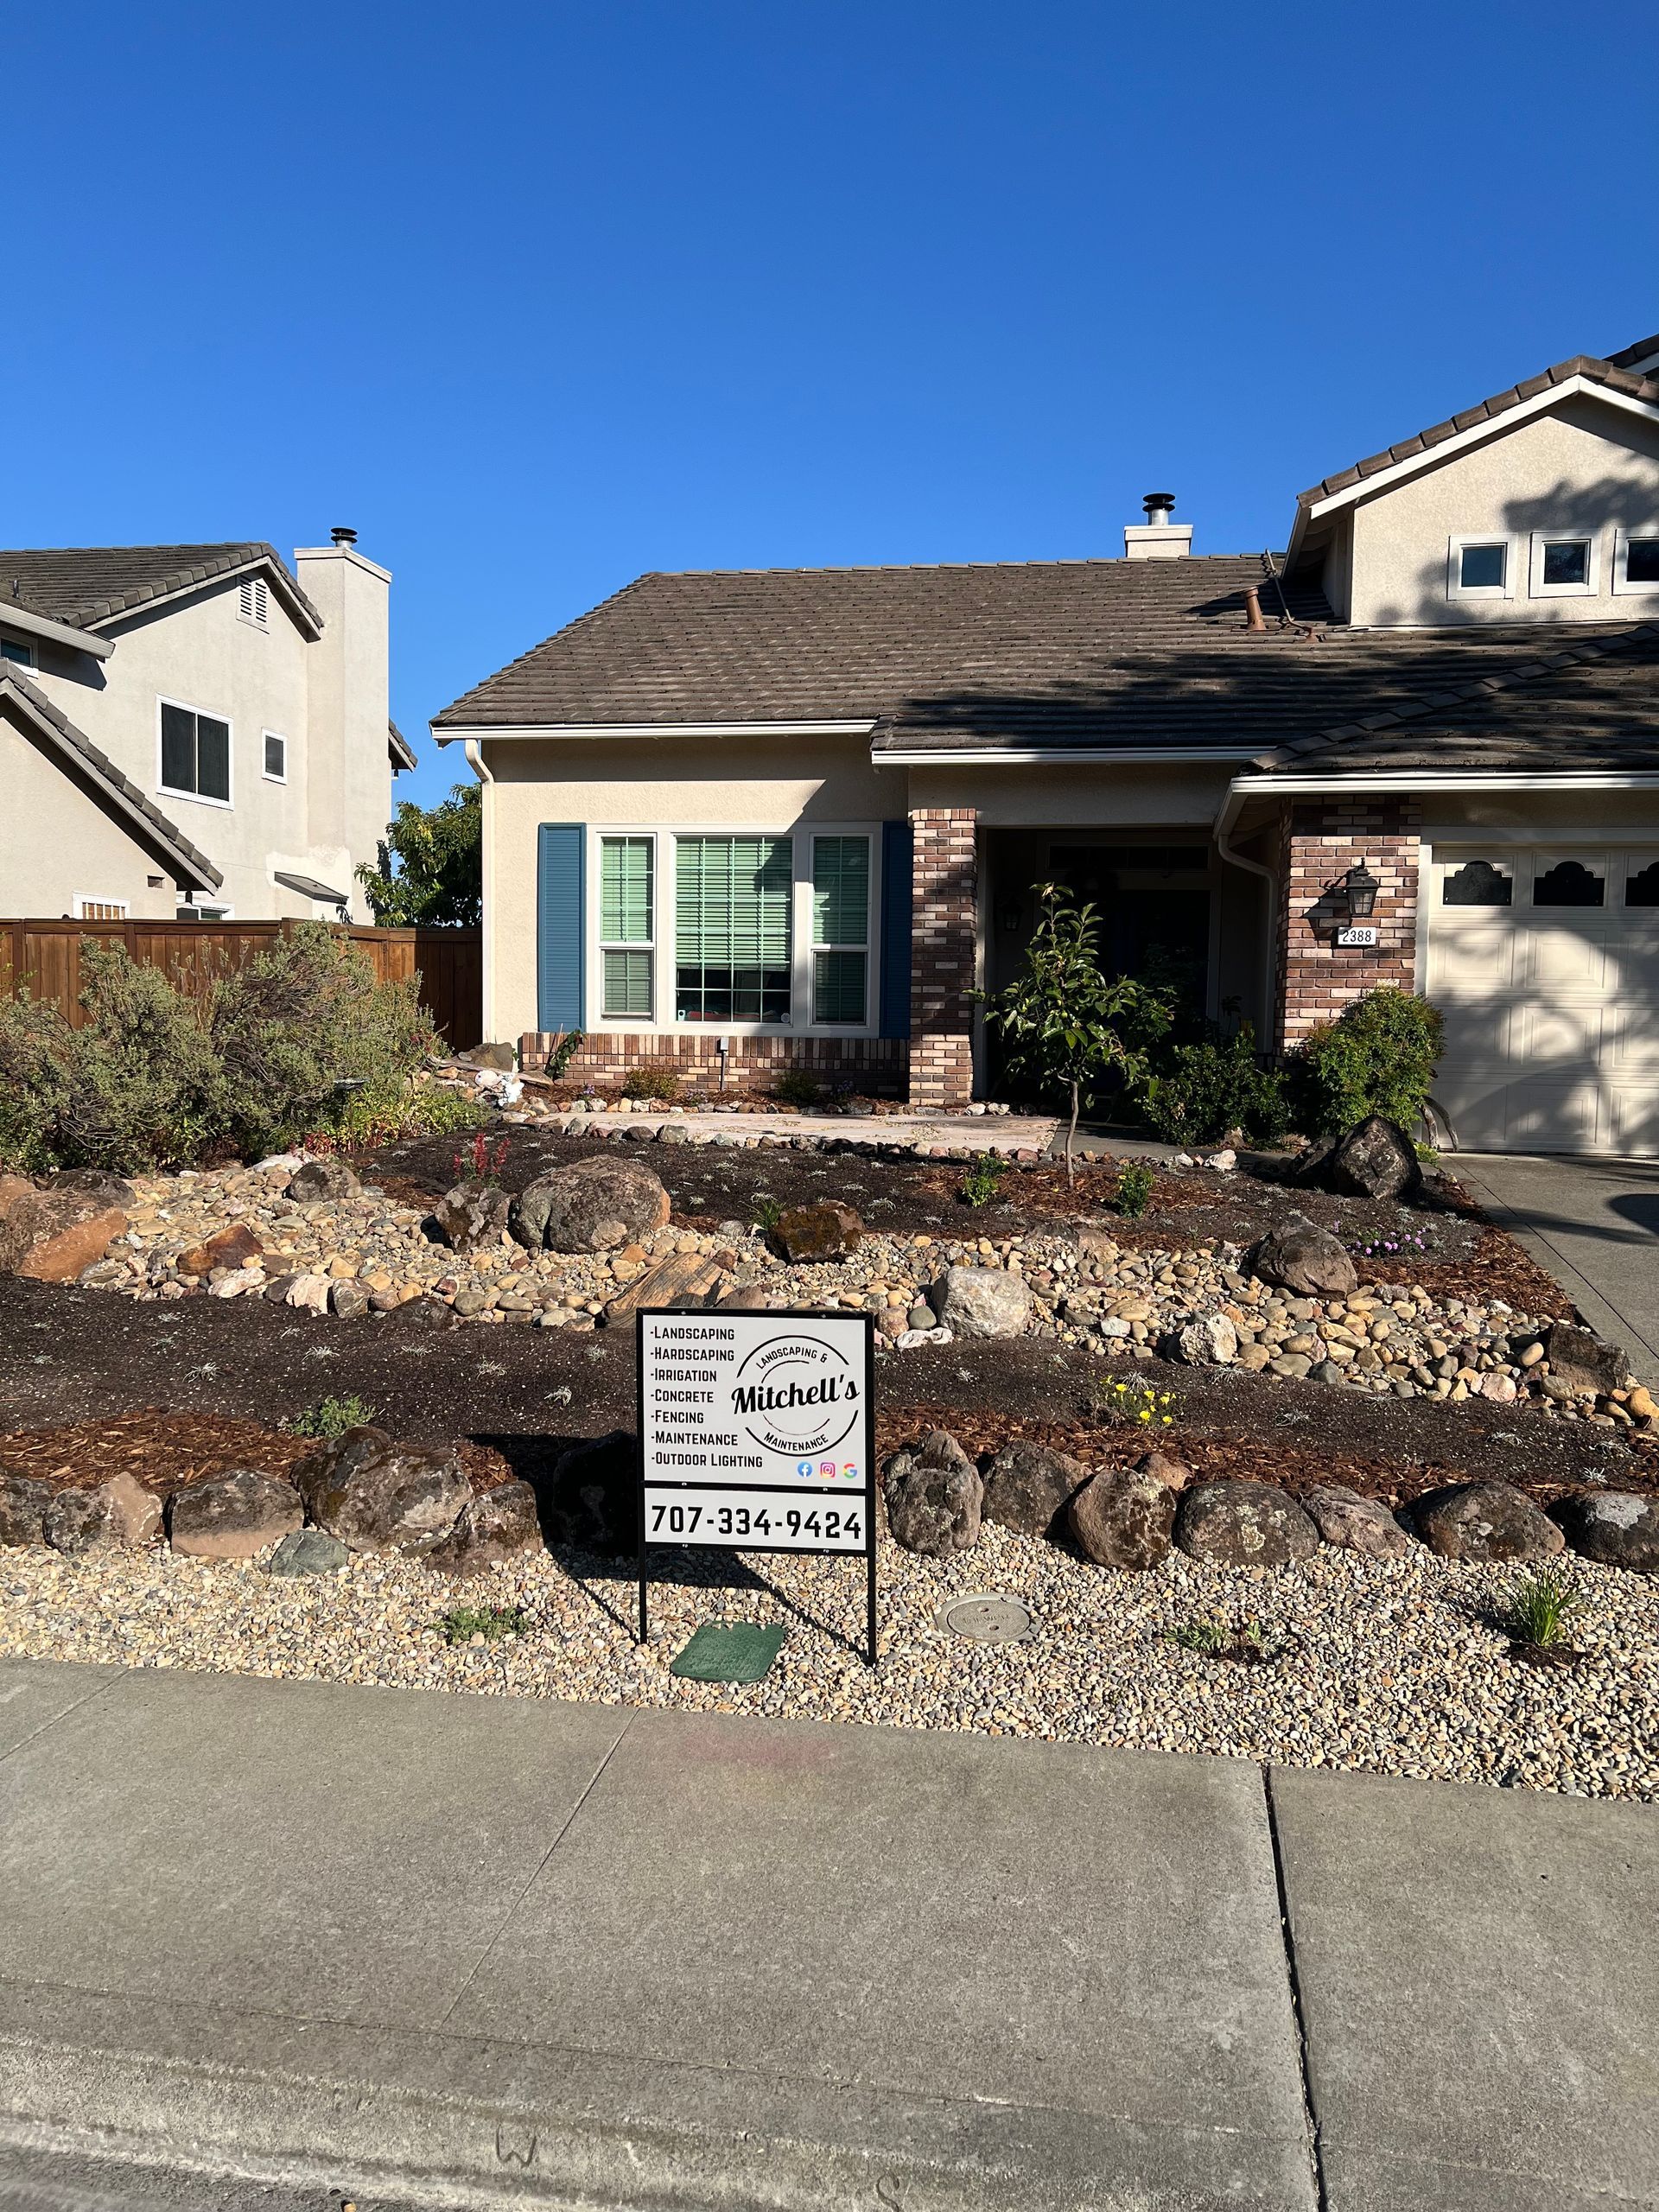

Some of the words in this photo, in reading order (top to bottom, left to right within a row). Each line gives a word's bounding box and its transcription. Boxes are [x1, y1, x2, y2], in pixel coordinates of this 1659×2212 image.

[1342, 930, 1372, 943] 2388
[650, 1325, 734, 1340] -LANDSCAPING
[650, 1346, 734, 1362] -HARDSCAPING
[755, 1346, 817, 1370] LANDSCAPING
[820, 1353, 828, 1363] &
[650, 1367, 717, 1382] -IRRIGATION
[650, 1389, 714, 1403] -CONCRETE
[731, 1374, 860, 1415] Mitchell's
[651, 1409, 704, 1424] -FENCING
[651, 1430, 739, 1446] -MAINTENANCE
[764, 1432, 829, 1452] MAINTENANCE
[651, 1451, 707, 1466] -OUTDOOR
[710, 1452, 763, 1468] LIGHTING
[652, 1505, 861, 1540] 707-334-9424
